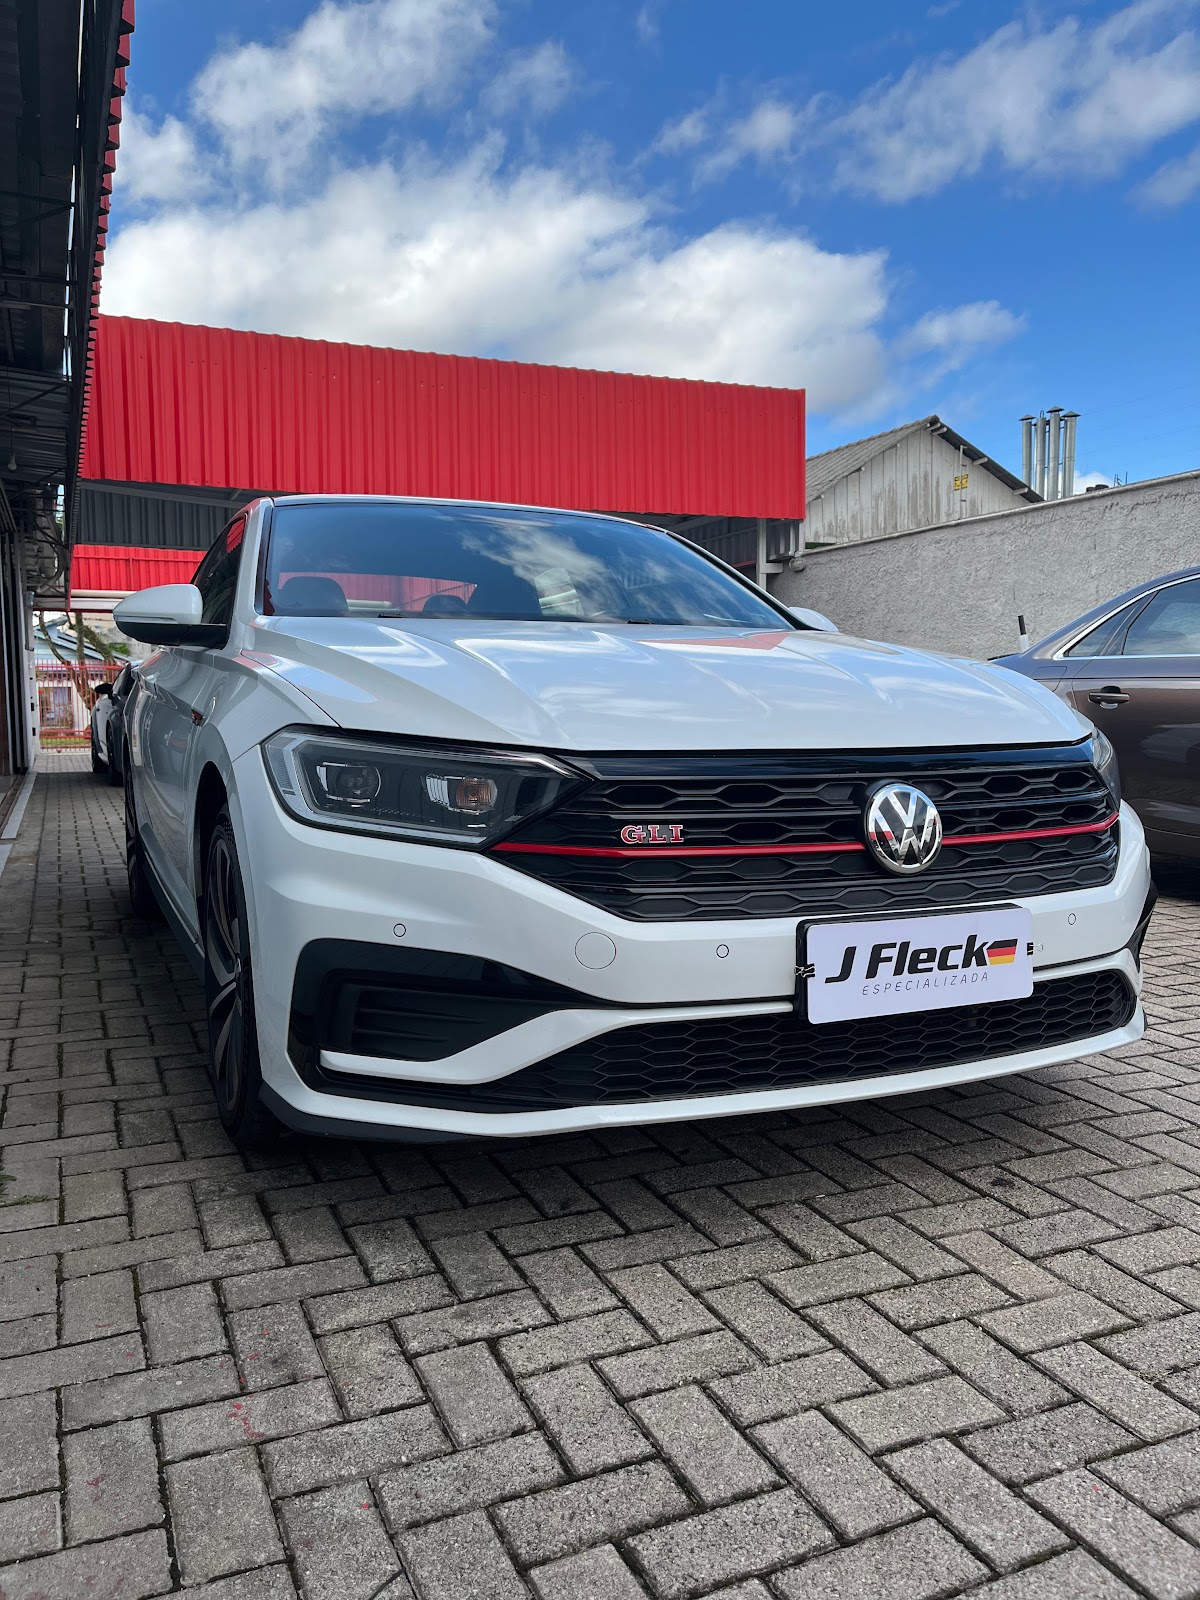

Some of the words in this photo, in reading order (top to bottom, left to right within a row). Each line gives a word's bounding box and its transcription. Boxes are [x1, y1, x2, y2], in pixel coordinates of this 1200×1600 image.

[620, 825, 684, 844] GLI
[824, 945, 858, 984] J
[865, 934, 989, 979] Fleck
[862, 971, 989, 996] ESPECIALIZADA
